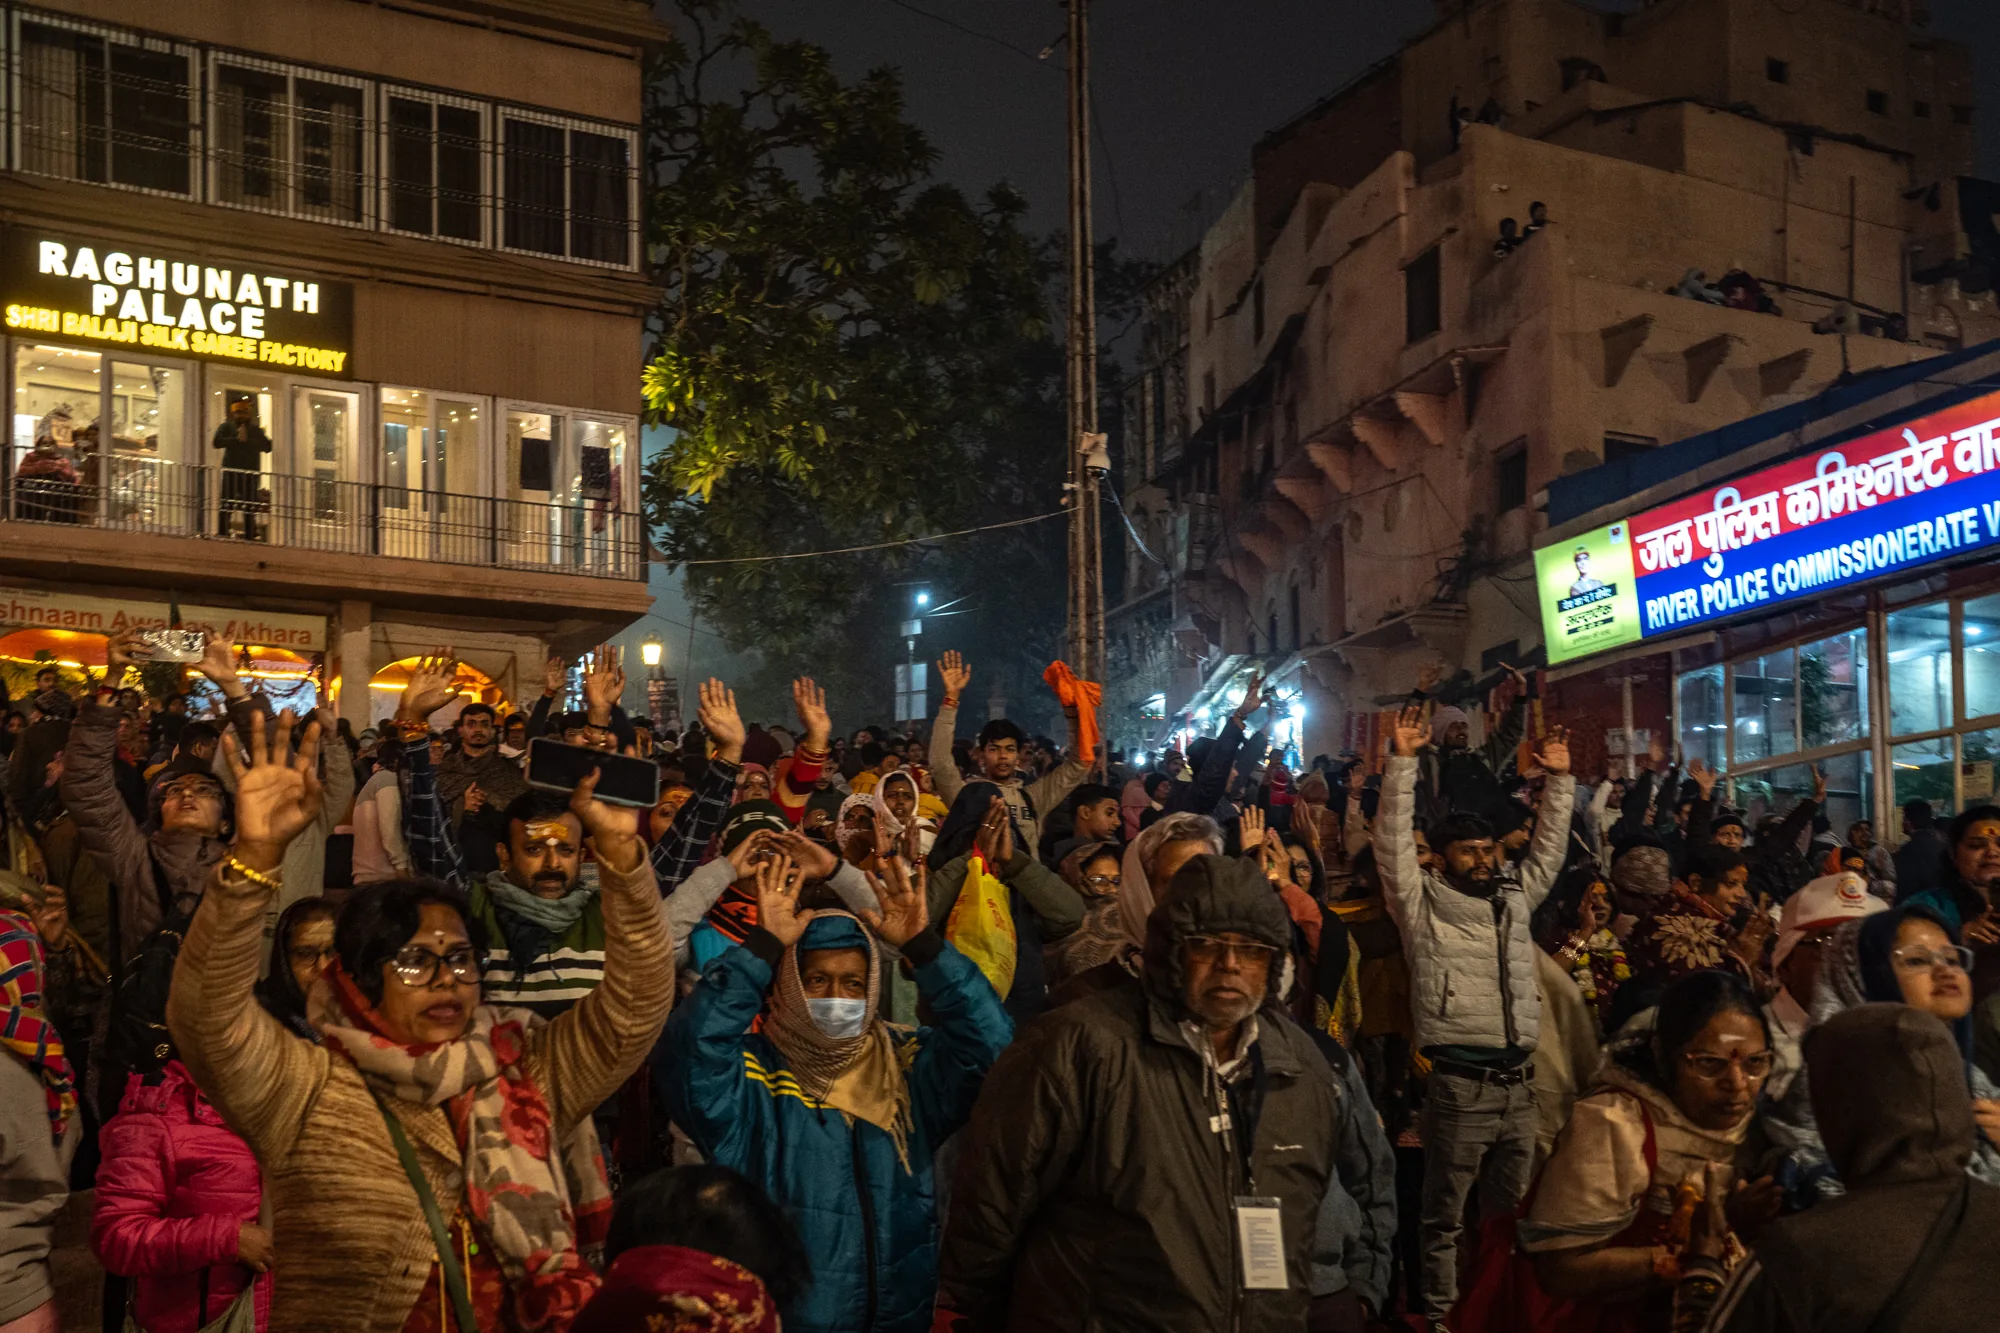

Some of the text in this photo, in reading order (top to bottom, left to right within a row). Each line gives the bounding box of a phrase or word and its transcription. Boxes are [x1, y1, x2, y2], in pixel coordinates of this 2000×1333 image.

[39, 241, 319, 314] RAGHUNATH
[92, 283, 265, 339] PALACE
[6, 304, 347, 372] SHRI BALAJI SILK SAREE FACTORY
[1635, 519, 1692, 571] जल
[1694, 487, 1781, 578] पुलिस
[1783, 427, 1949, 526] कमिश्नरेट
[1645, 588, 1701, 629] RIVER
[1701, 568, 1769, 615] POLICE
[1771, 507, 1980, 596] COMMISSIONERATE
[223, 620, 311, 645] Akhara
